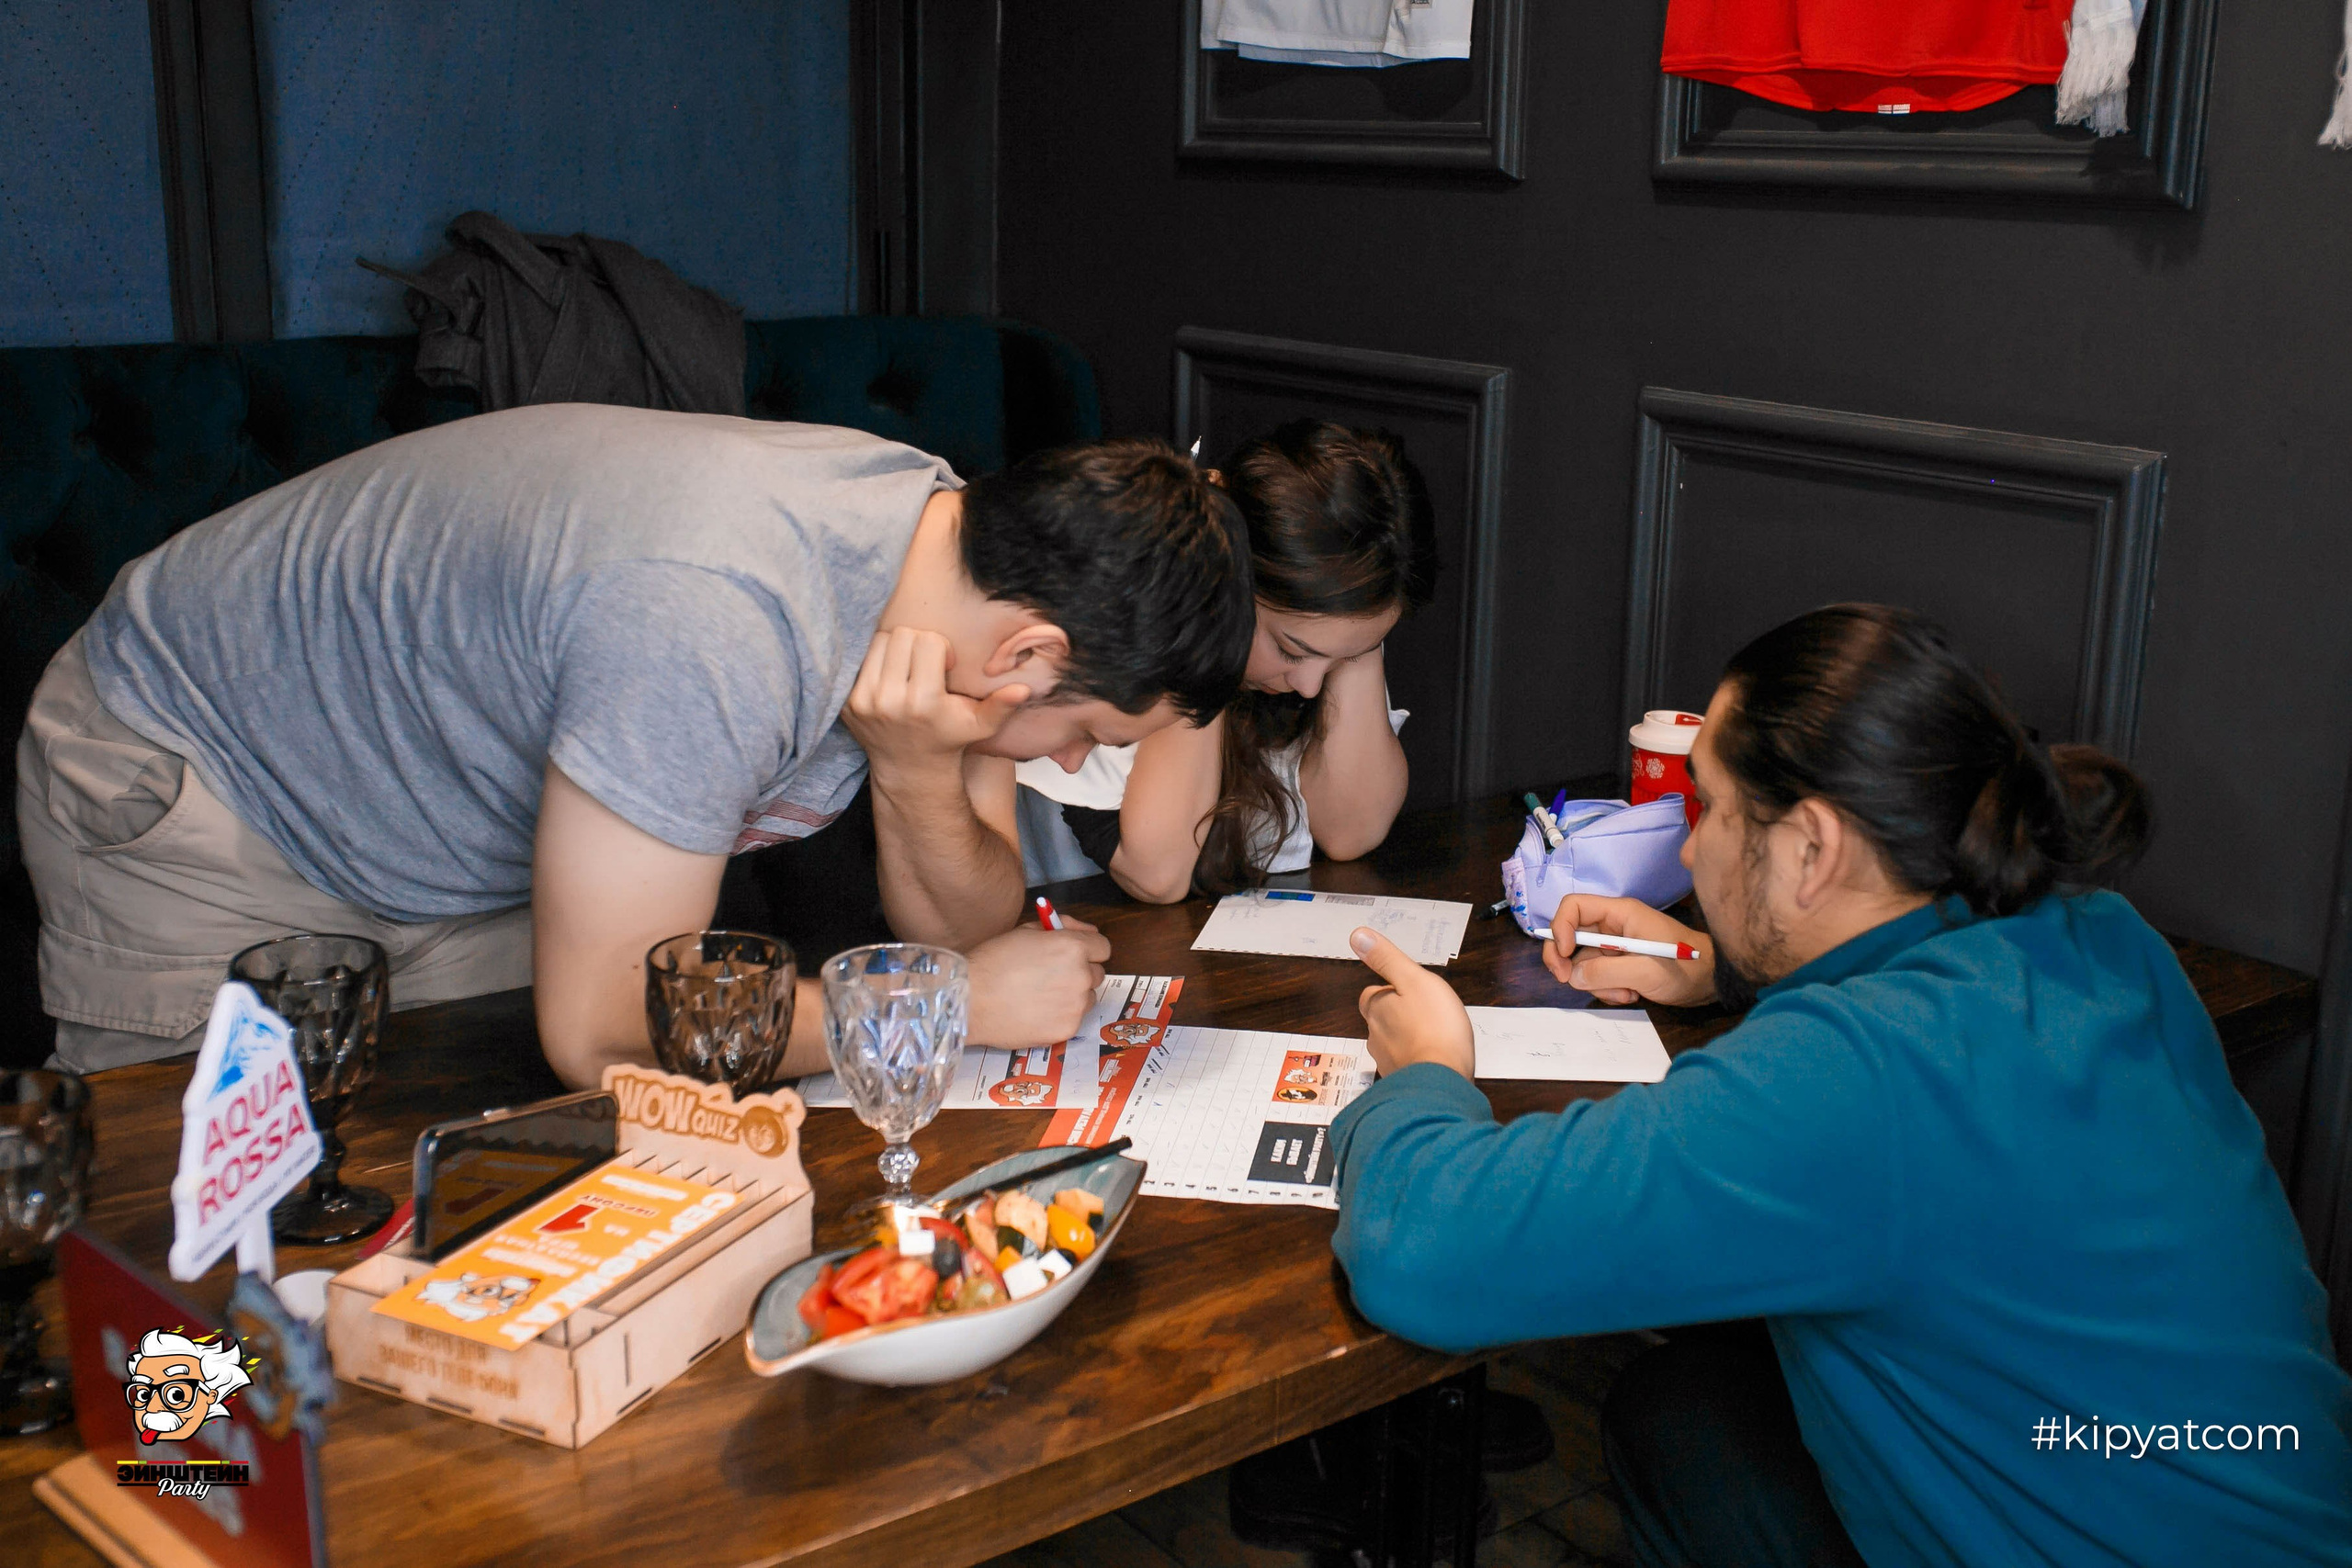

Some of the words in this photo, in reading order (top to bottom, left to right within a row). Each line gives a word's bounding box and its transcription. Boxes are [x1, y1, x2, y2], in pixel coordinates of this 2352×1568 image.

[201, 1059, 296, 1165] AQUA
[613, 1075, 700, 1134] WOW
[198, 1103, 306, 1227] ROSSA
[538, 1203, 600, 1232] 1
[497, 1191, 736, 1343] СЕРТИФИКАТ
